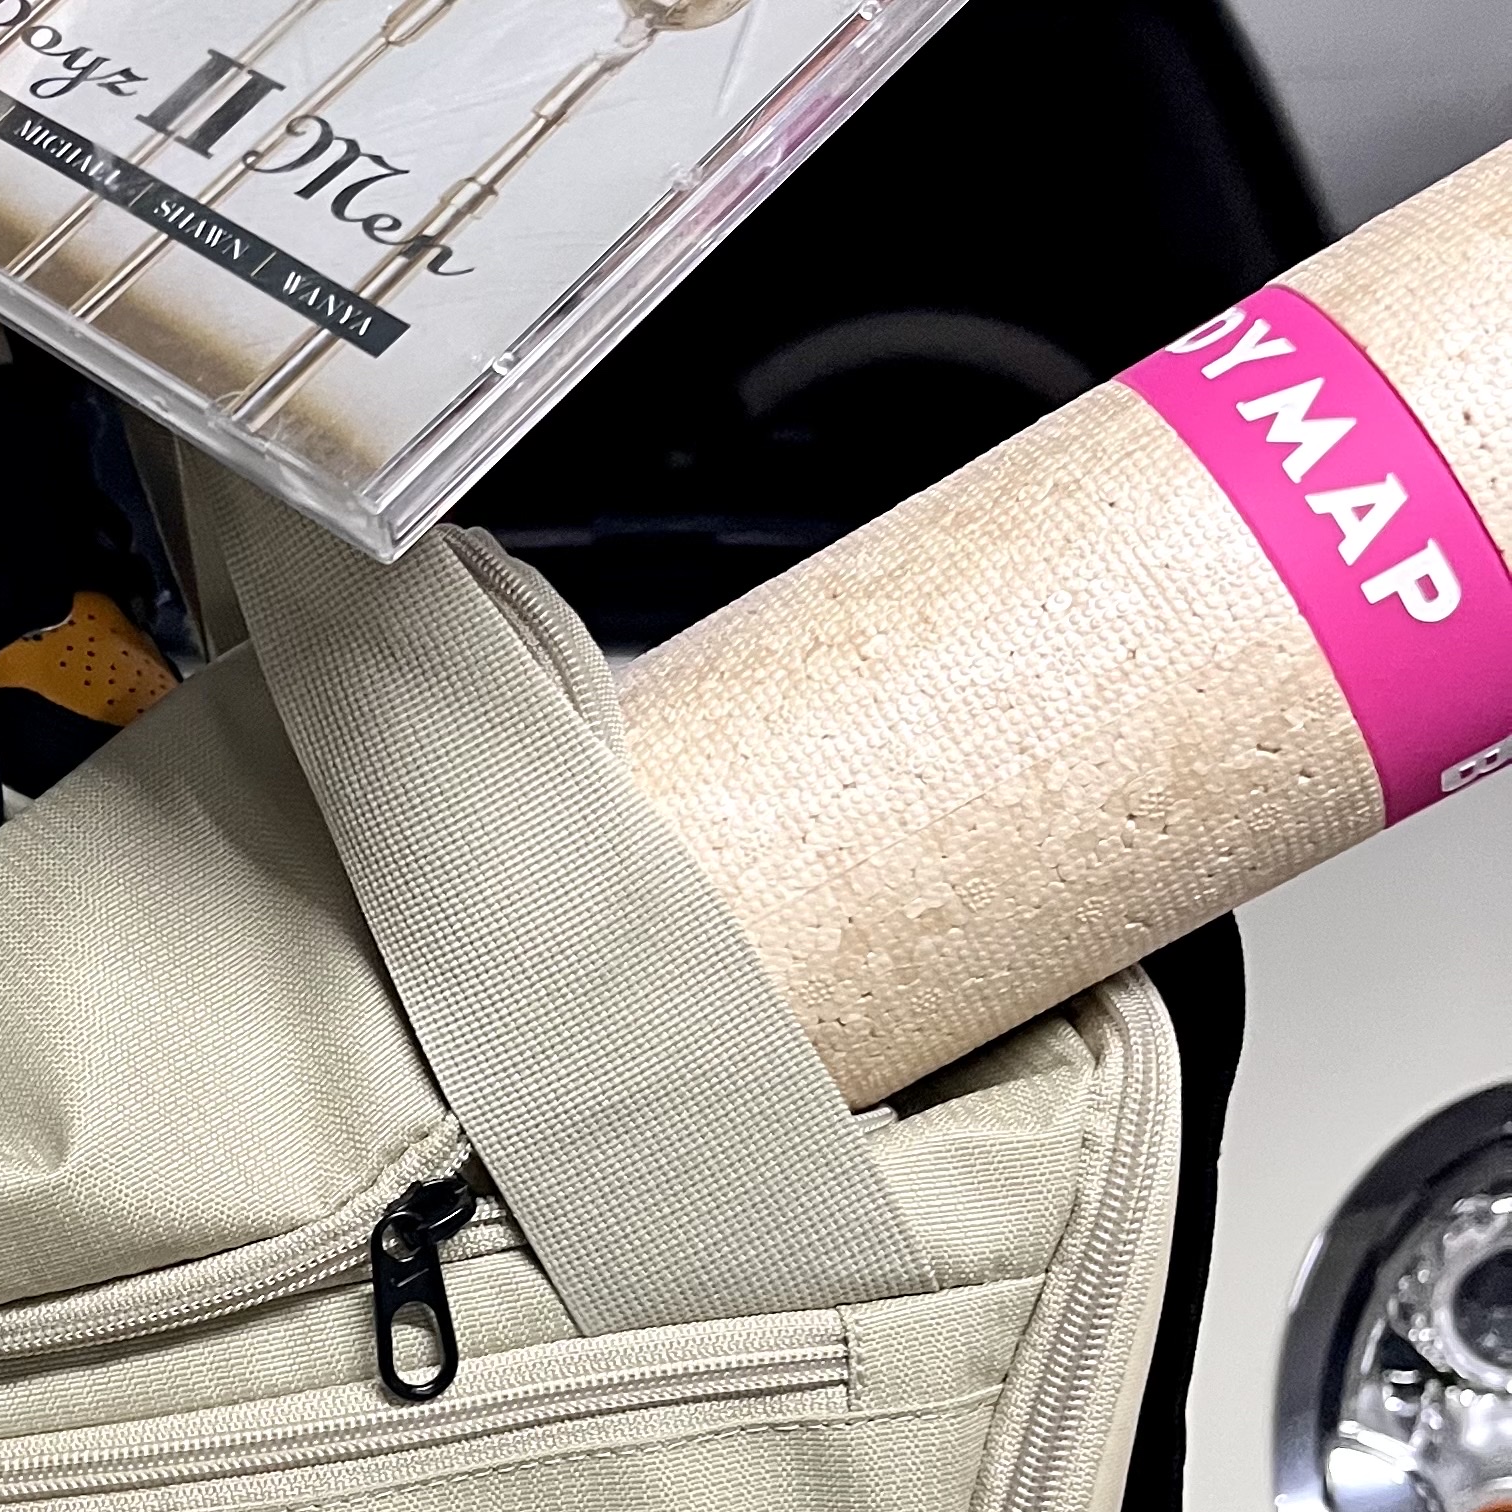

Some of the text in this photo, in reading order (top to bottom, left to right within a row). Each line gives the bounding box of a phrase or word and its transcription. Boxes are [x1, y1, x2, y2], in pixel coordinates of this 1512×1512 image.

[134, 48, 287, 160] II
[242, 113, 476, 277] Men
[152, 199, 251, 261] SHAWN
[281, 270, 374, 336] WANYA
